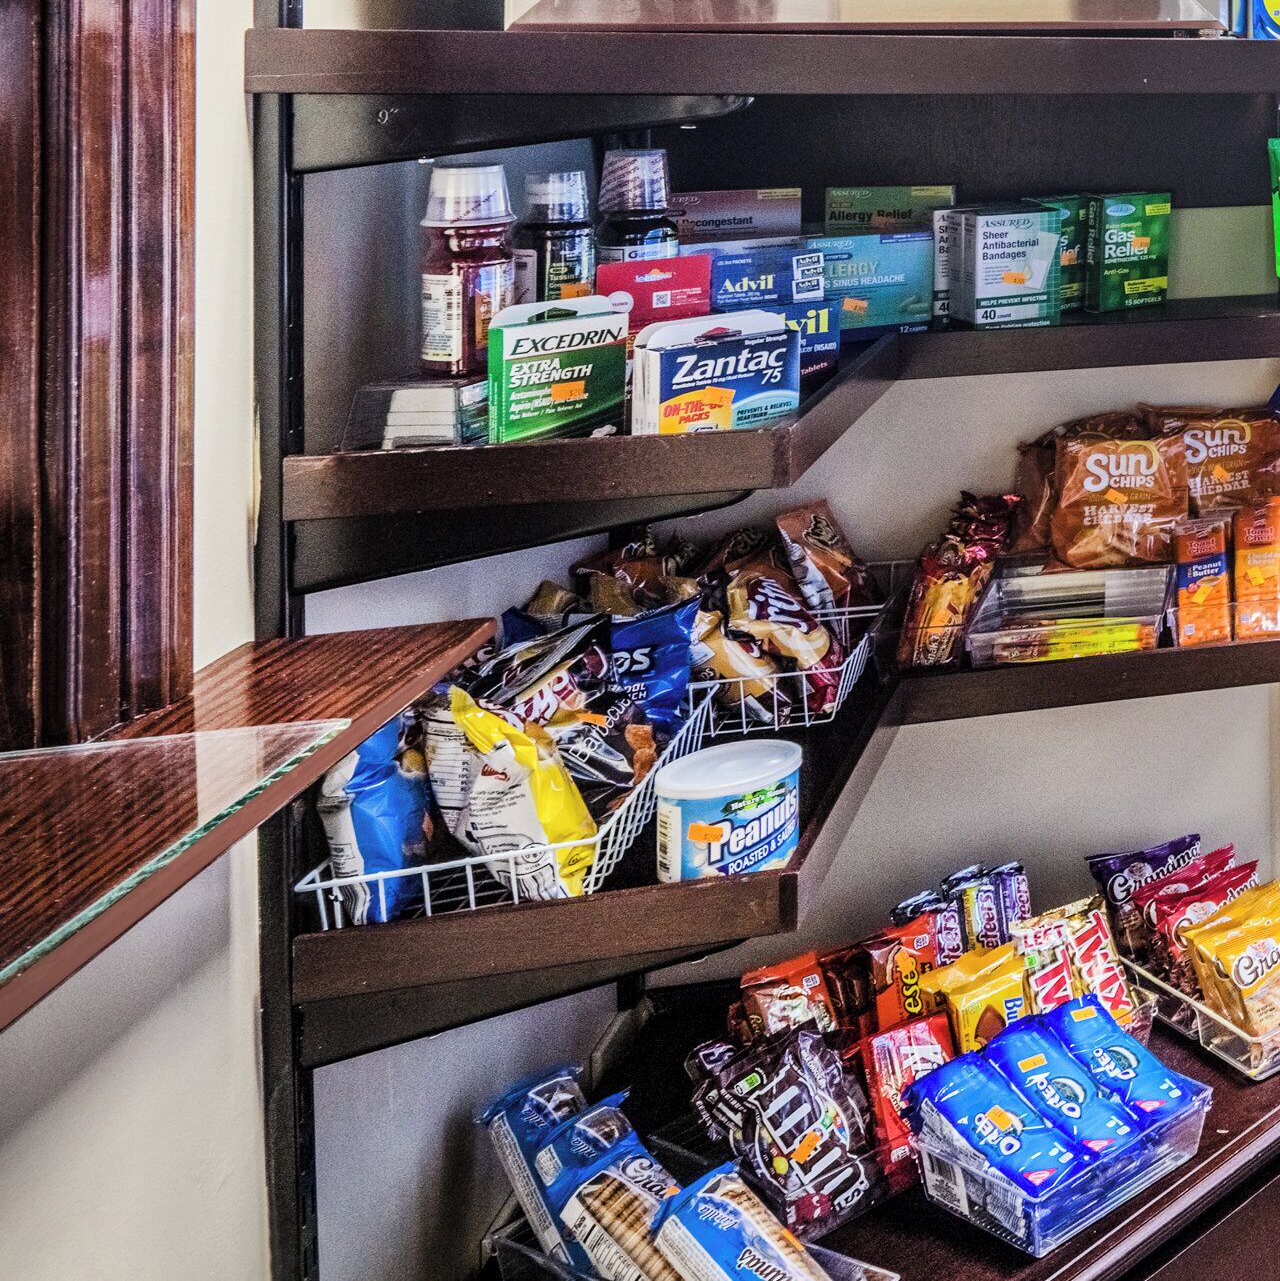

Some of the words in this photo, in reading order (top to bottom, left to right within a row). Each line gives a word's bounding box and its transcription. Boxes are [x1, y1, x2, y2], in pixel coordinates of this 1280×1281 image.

[828, 210, 873, 222] Allergy
[981, 218, 1034, 229] ASSURED
[981, 231, 1008, 241] Sheer
[1104, 229, 1136, 244] Gas
[807, 240, 855, 250] ASSURED
[981, 238, 1040, 251] Antibacterial
[799, 255, 818, 264] Advil
[981, 250, 1027, 261] Bandages
[804, 268, 823, 276] Advil
[1104, 268, 1130, 276] Anti-Gas
[718, 274, 774, 294] Advil
[797, 280, 818, 289] Advil
[833, 276, 859, 288] SINUS
[861, 273, 906, 286] HEADACHE
[980, 299, 998, 307] HELPS
[998, 297, 1021, 305] PREVENT
[1021, 295, 1048, 303] INFECTION
[1132, 296, 1162, 306] SOFTGELS
[981, 309, 996, 320] 40
[509, 327, 623, 356] EXCEDRIN
[744, 336, 765, 346] Regular
[766, 335, 788, 344] Strength
[510, 358, 561, 378] EXTRA
[671, 347, 788, 385] Zantac
[760, 368, 784, 385] 75
[800, 361, 828, 376] Tablets
[508, 364, 594, 389] STRENGTH
[736, 404, 764, 415] PREVENTS
[678, 412, 710, 424] PACKS
[1183, 428, 1250, 464] Sun
[1208, 444, 1248, 458] CHIPS
[1083, 453, 1157, 493] Sun
[1110, 474, 1155, 488] CHIPS
[1083, 504, 1157, 517] HARVEST
[1244, 527, 1275, 536] Toast
[1188, 538, 1216, 547] Toast
[1245, 534, 1275, 543] Chee
[1187, 545, 1216, 556] Chee
[1192, 560, 1222, 571] Peanut
[1192, 567, 1220, 578] Butter
[708, 786, 799, 861] Peanuts
[728, 849, 768, 875] ROASTED
[769, 841, 777, 853] &
[1023, 923, 1064, 948] LEFT
[1072, 910, 1133, 1014] TWIX
[1093, 1048, 1137, 1080] OREO
[1037, 1079, 1082, 1119] OREO
